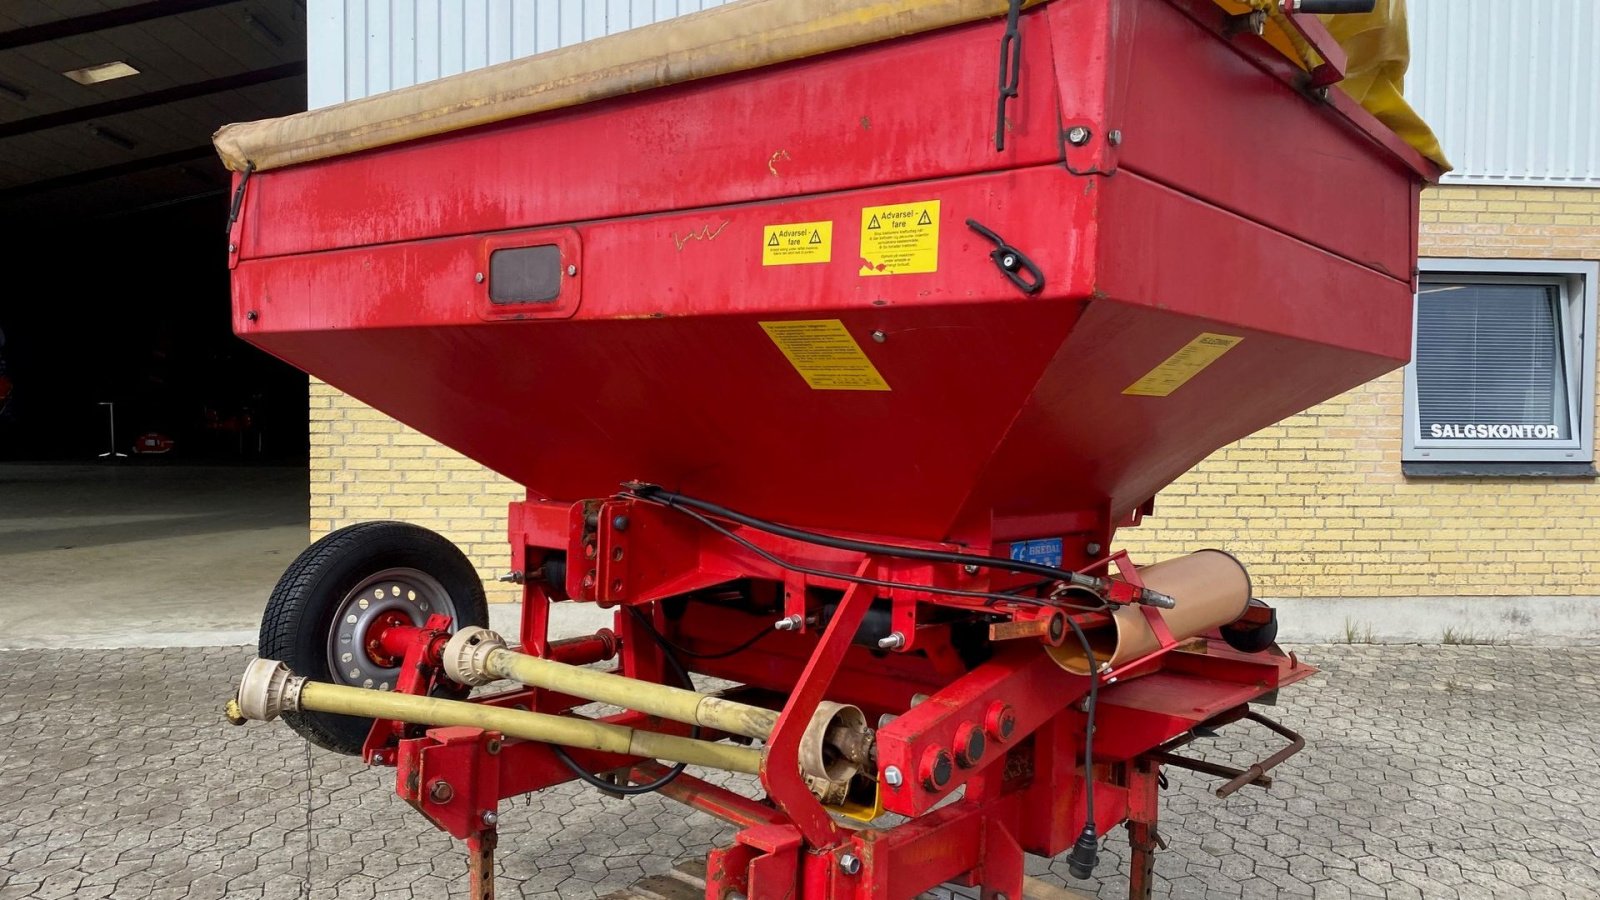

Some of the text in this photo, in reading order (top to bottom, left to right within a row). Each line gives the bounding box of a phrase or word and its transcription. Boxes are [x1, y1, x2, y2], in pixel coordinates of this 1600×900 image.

[881, 210, 914, 220] Advarsel
[892, 220, 906, 228] fare
[779, 229, 807, 237] Advarsel
[1430, 423, 1559, 438] SALGSKONTOR
[1029, 545, 1060, 555] BREDAL
